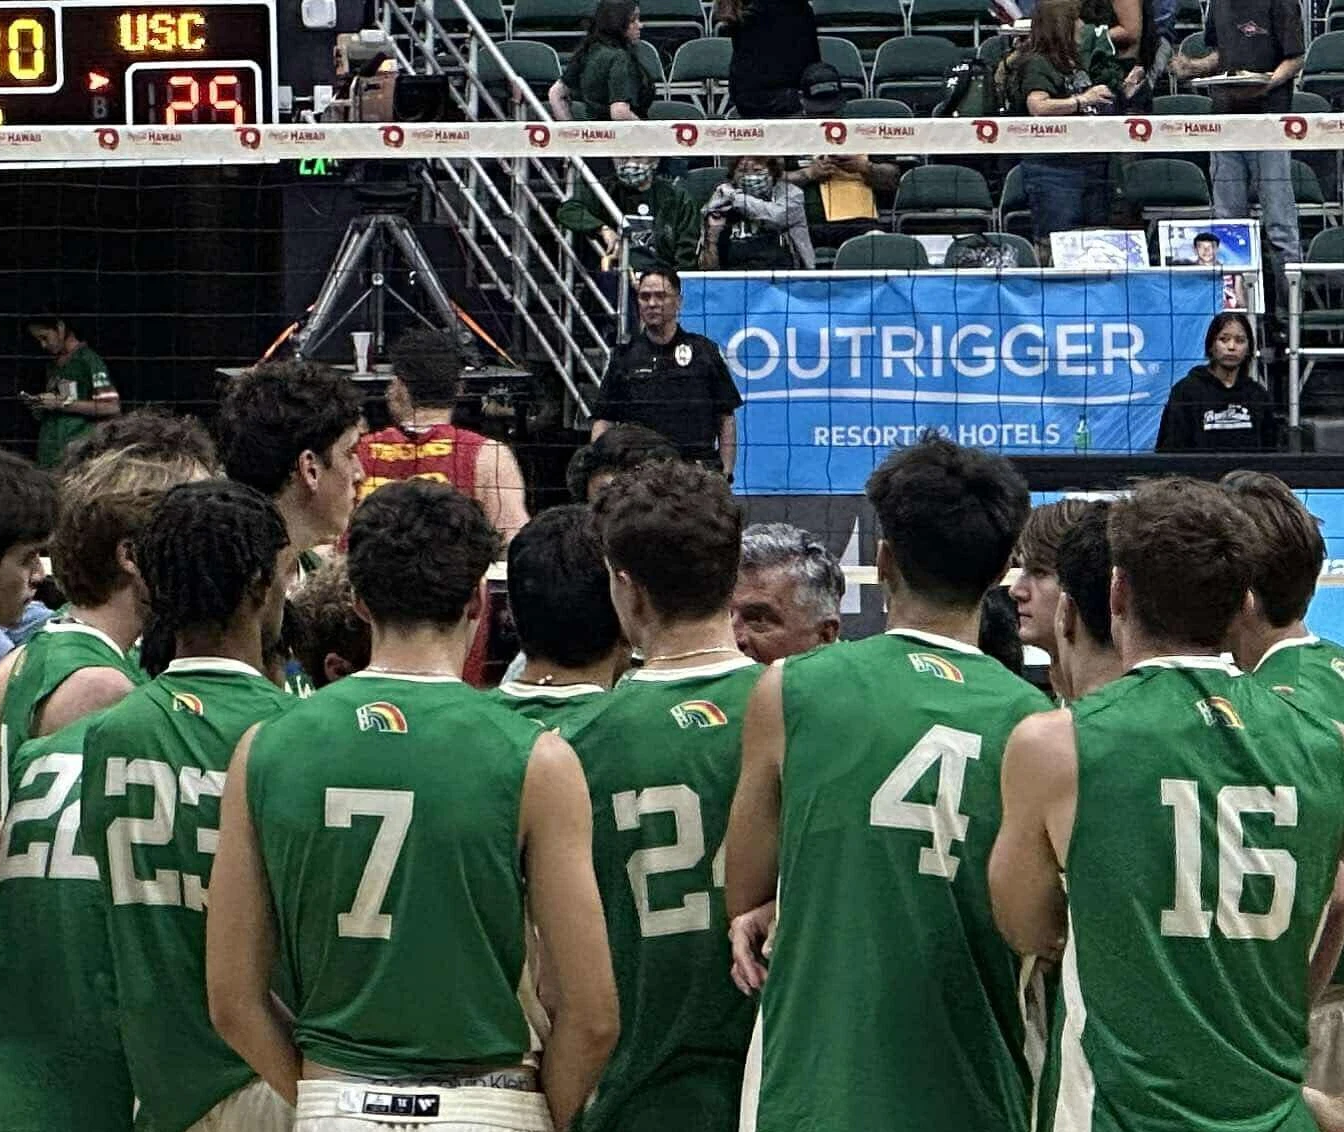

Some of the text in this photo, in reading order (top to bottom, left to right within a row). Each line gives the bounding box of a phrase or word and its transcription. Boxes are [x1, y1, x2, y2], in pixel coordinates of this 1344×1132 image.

[119, 12, 206, 51] USC
[726, 323, 1147, 380] OUTRIGGER
[959, 424, 1061, 445] HOTELS
[324, 788, 416, 940] 7
[612, 784, 726, 938] 2
[870, 723, 982, 882] 4
[1160, 778, 1299, 941] 16
